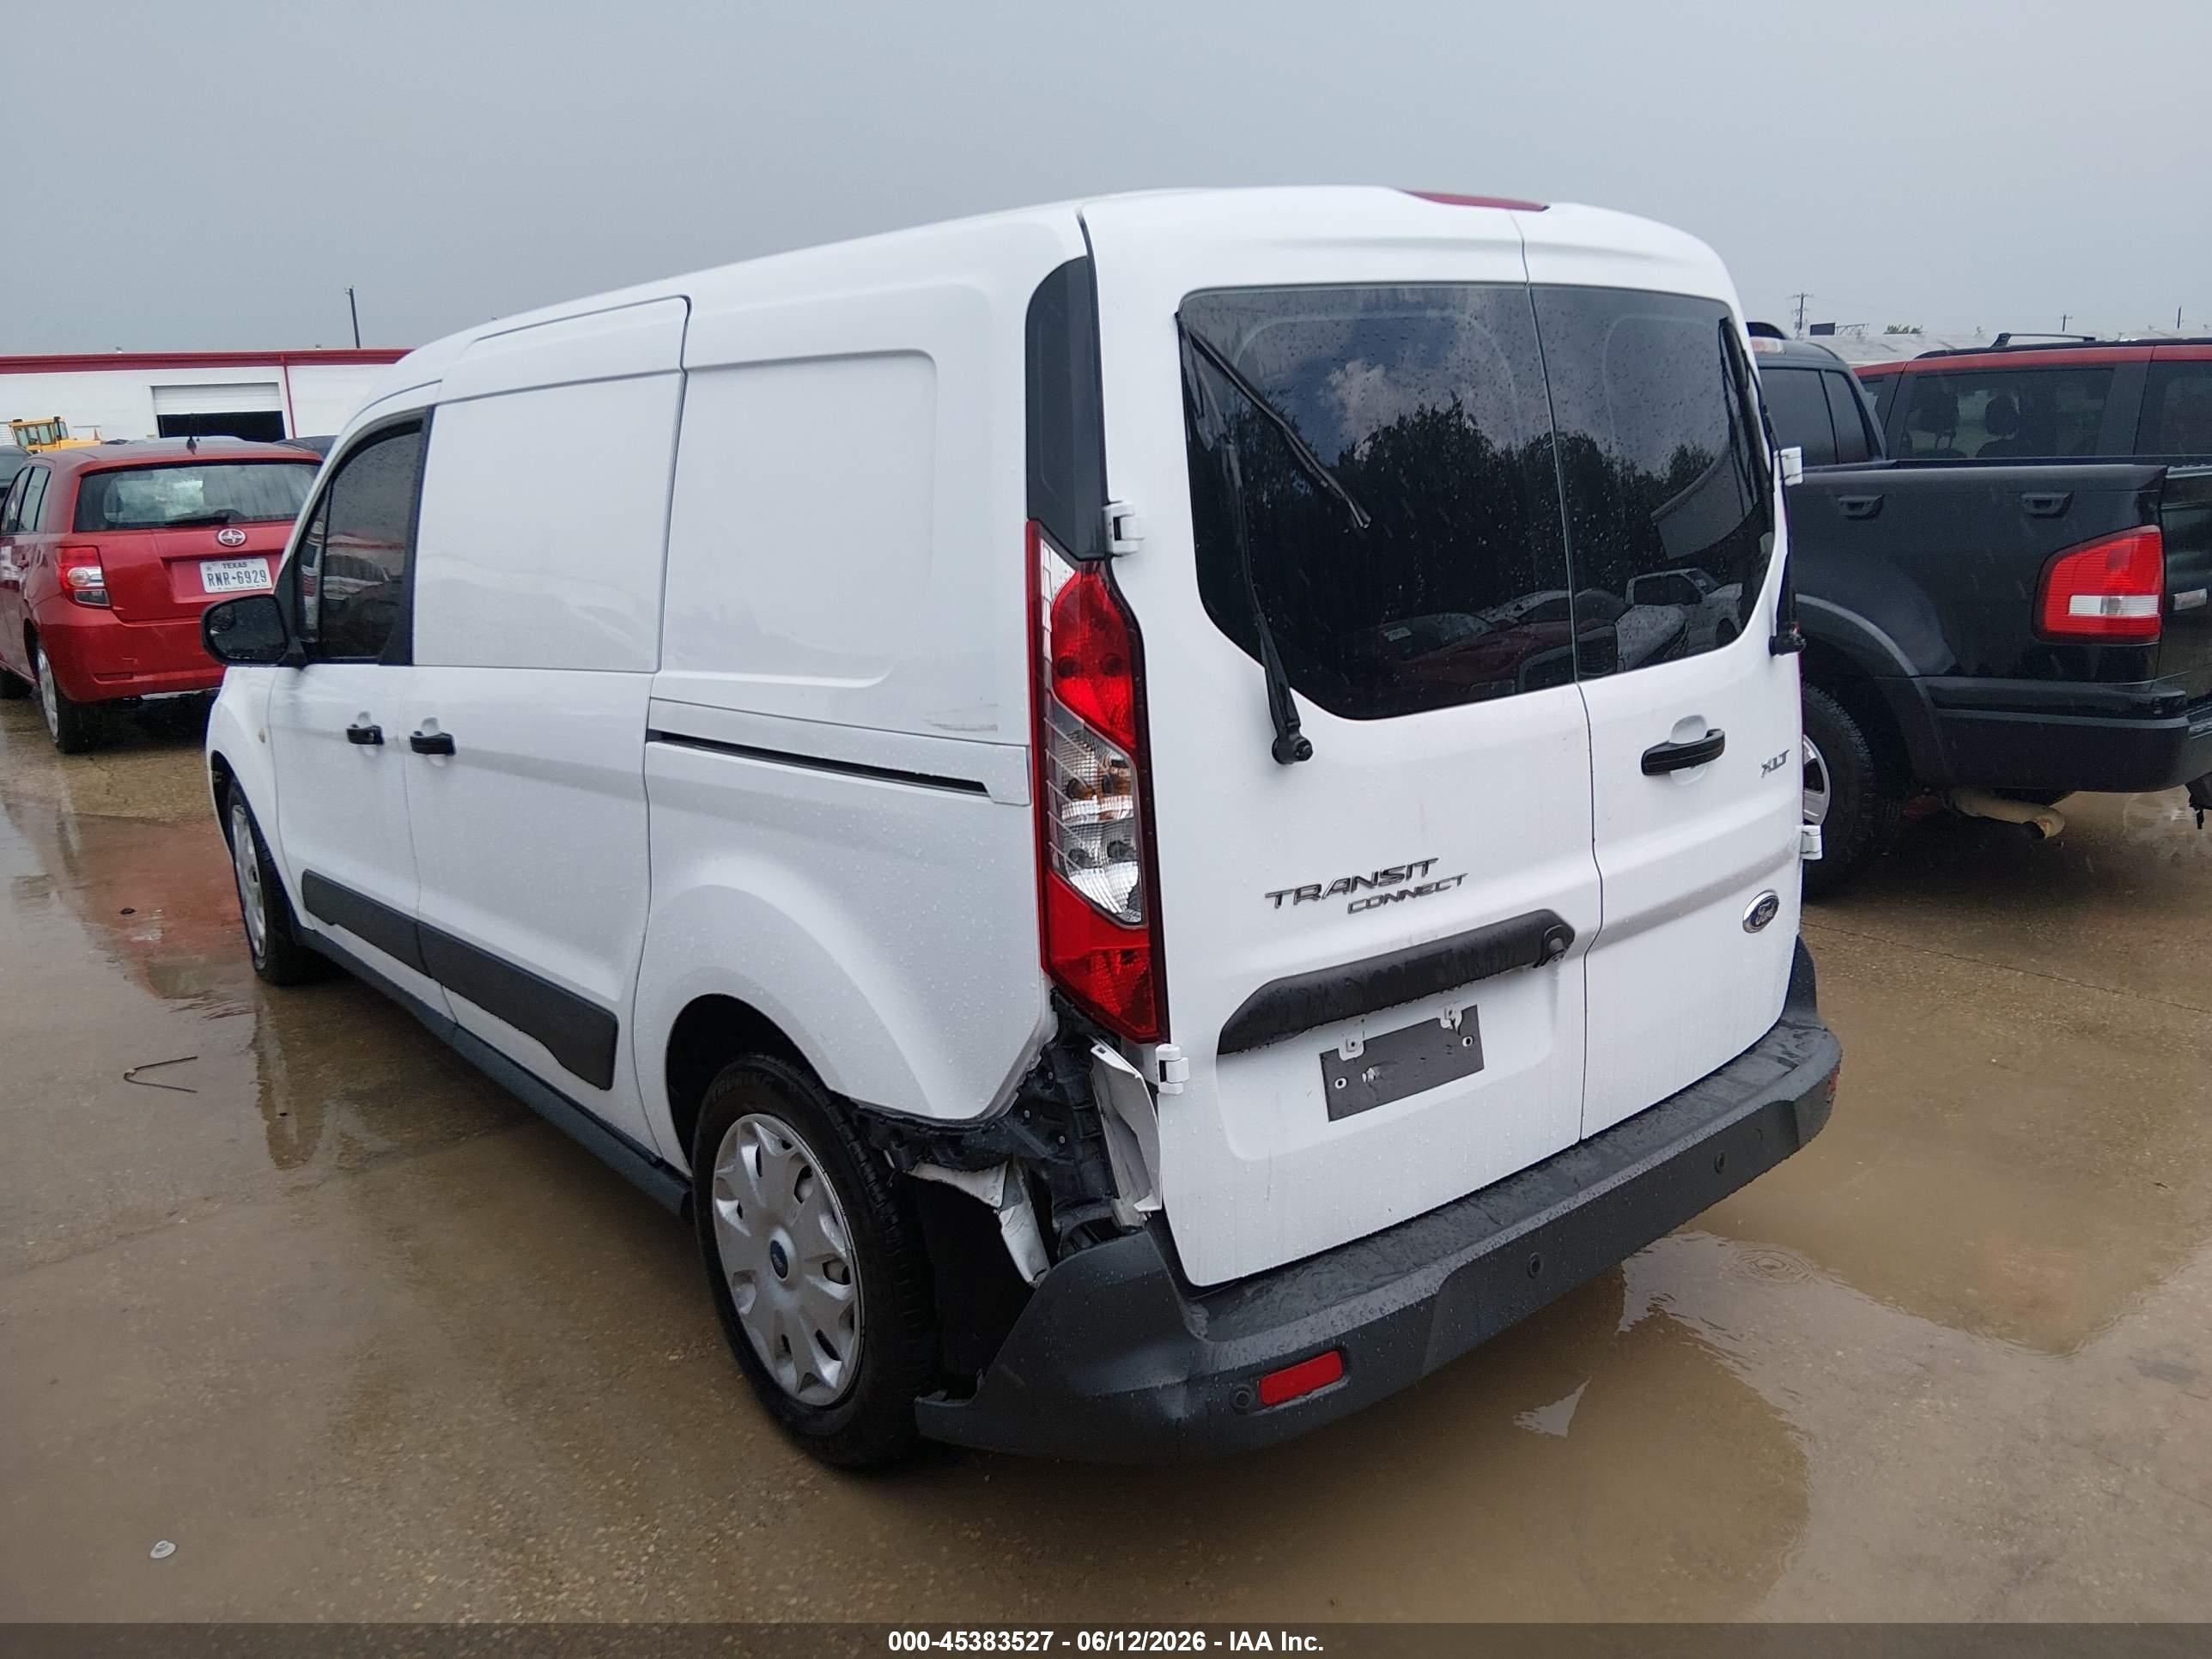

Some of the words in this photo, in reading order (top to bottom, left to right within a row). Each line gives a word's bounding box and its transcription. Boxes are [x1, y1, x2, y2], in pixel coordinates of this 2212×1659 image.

[1761, 750, 1790, 778] XLT
[1265, 857, 1439, 909] TRANSIT
[1347, 872, 1469, 915] CONNECT
